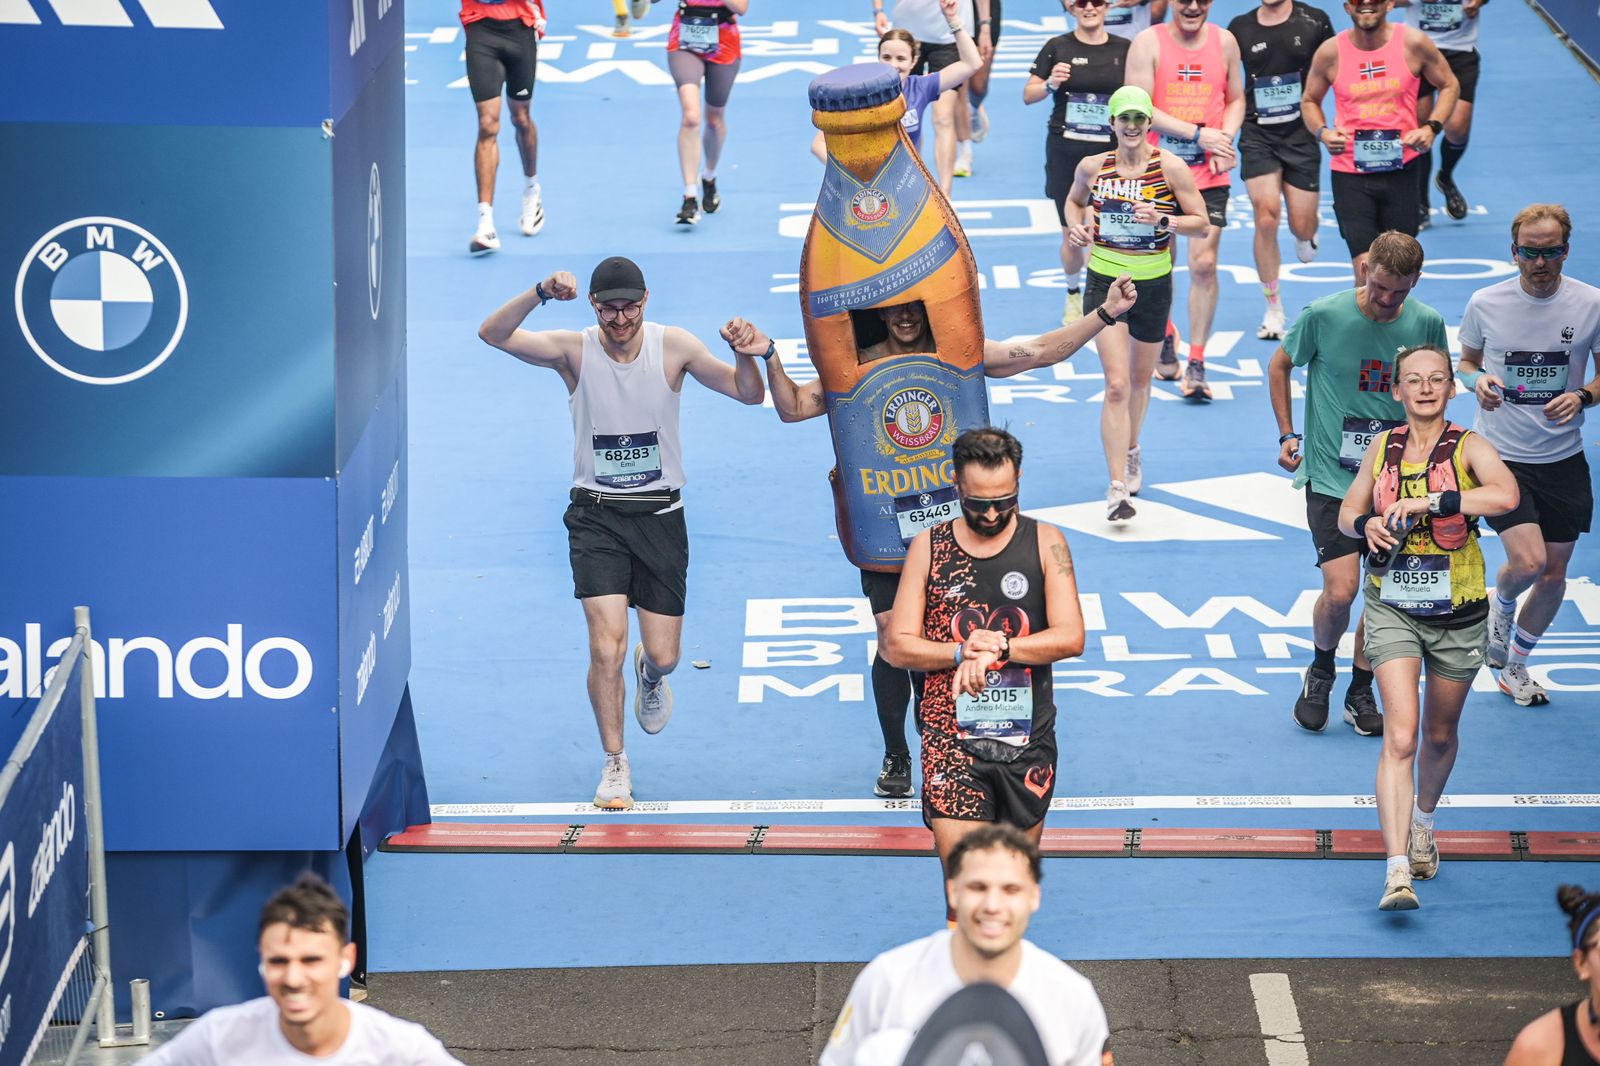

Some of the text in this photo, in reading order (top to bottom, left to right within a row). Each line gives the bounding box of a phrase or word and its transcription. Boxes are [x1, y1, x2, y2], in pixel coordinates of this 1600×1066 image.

[1166, 83, 1212, 96] BERLIN
[1263, 86, 1293, 97] 53148
[1350, 79, 1400, 96] BERLIN
[1076, 104, 1106, 114] 52475
[1363, 141, 1394, 151] 66351
[1092, 178, 1146, 201] JAMIE
[853, 189, 885, 205] ERDINGER
[1110, 214, 1143, 225] 5922
[38, 226, 164, 272] BMW
[833, 257, 936, 307] KALORIENREDUZIERT
[1517, 367, 1557, 377] 89185
[1519, 391, 1553, 399] zalando
[885, 391, 937, 419] ERDINGER
[604, 447, 650, 461] 68283
[612, 473, 646, 483] zalando
[859, 458, 956, 497] ERDING
[909, 504, 951, 523] 63449
[1392, 571, 1439, 584] 80595
[1400, 585, 1431, 593] Manuela
[1397, 601, 1434, 609] zalando
[744, 589, 1325, 636] BW
[742, 633, 1362, 669] BLIN
[965, 703, 1024, 712] Andrea Michele
[975, 720, 1013, 729] zalando
[27, 780, 76, 919] zalando
